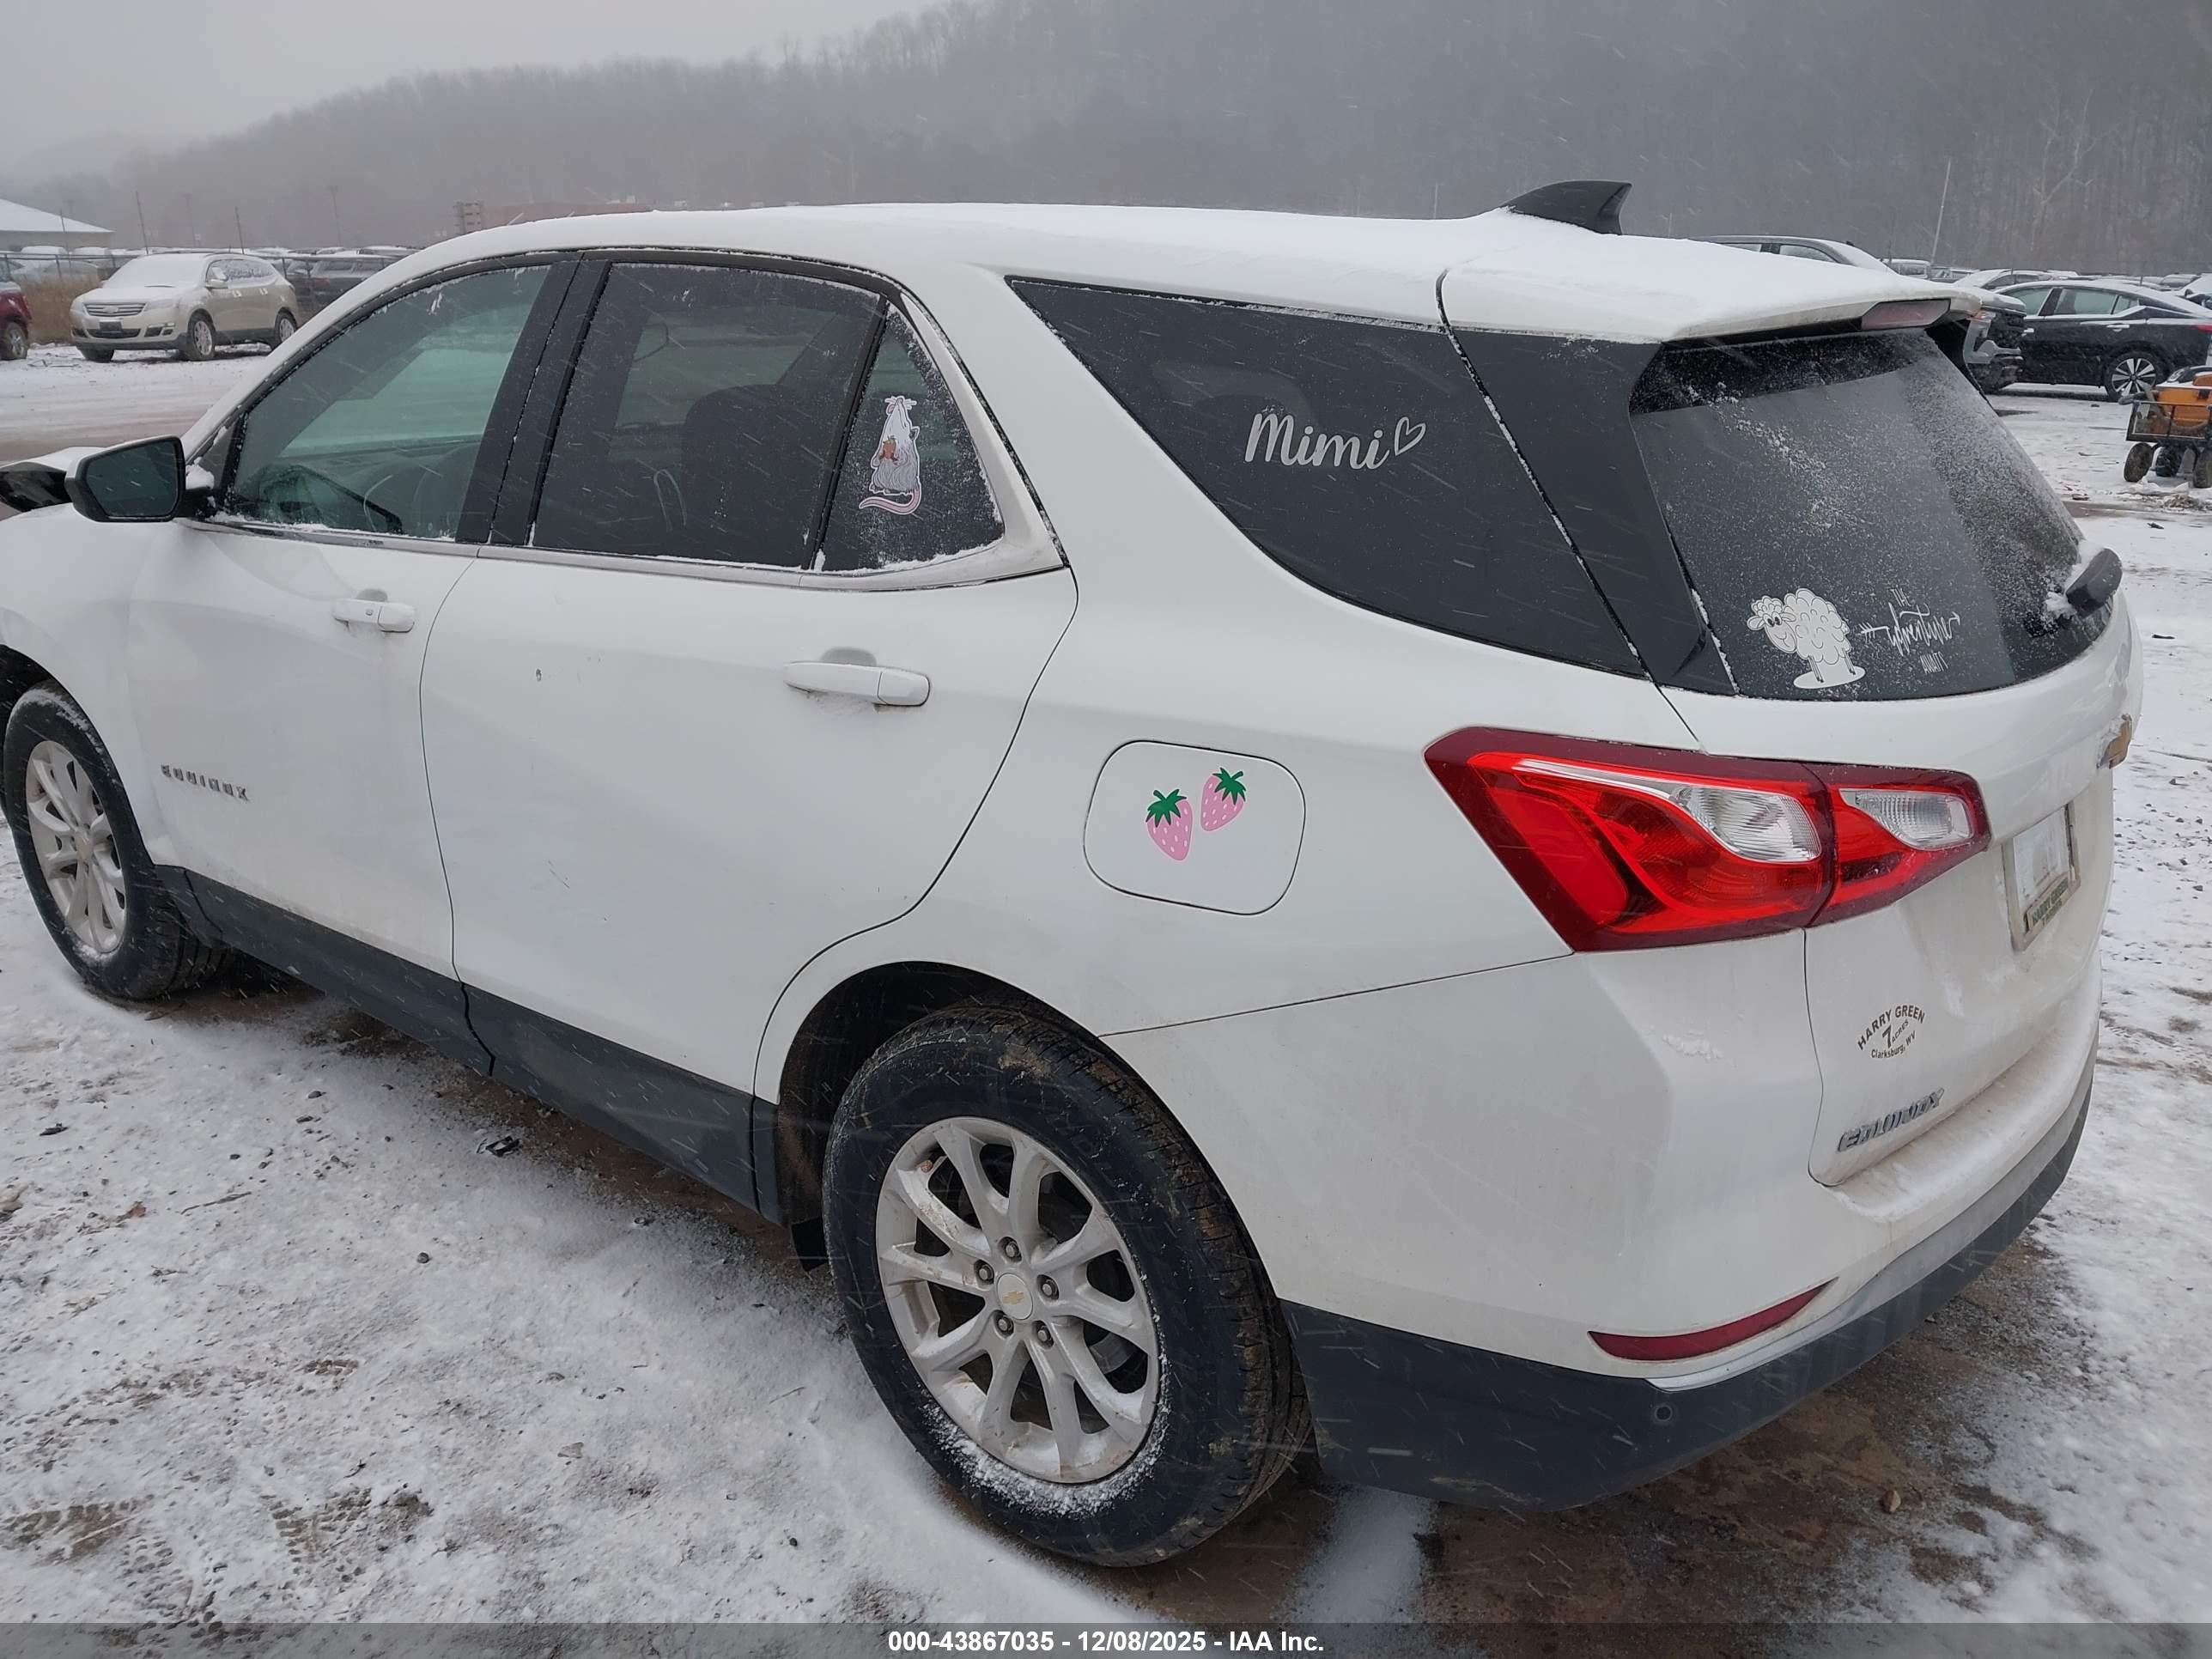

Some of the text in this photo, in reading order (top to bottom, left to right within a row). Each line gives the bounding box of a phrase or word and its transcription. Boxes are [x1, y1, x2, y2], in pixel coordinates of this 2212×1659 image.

[1244, 413, 1389, 470] Mimi
[1857, 1005, 1925, 1051] HARRY GREEN
[1871, 1030, 1916, 1059] Clarksburg, WV
[1881, 1024, 1893, 1049] 7
